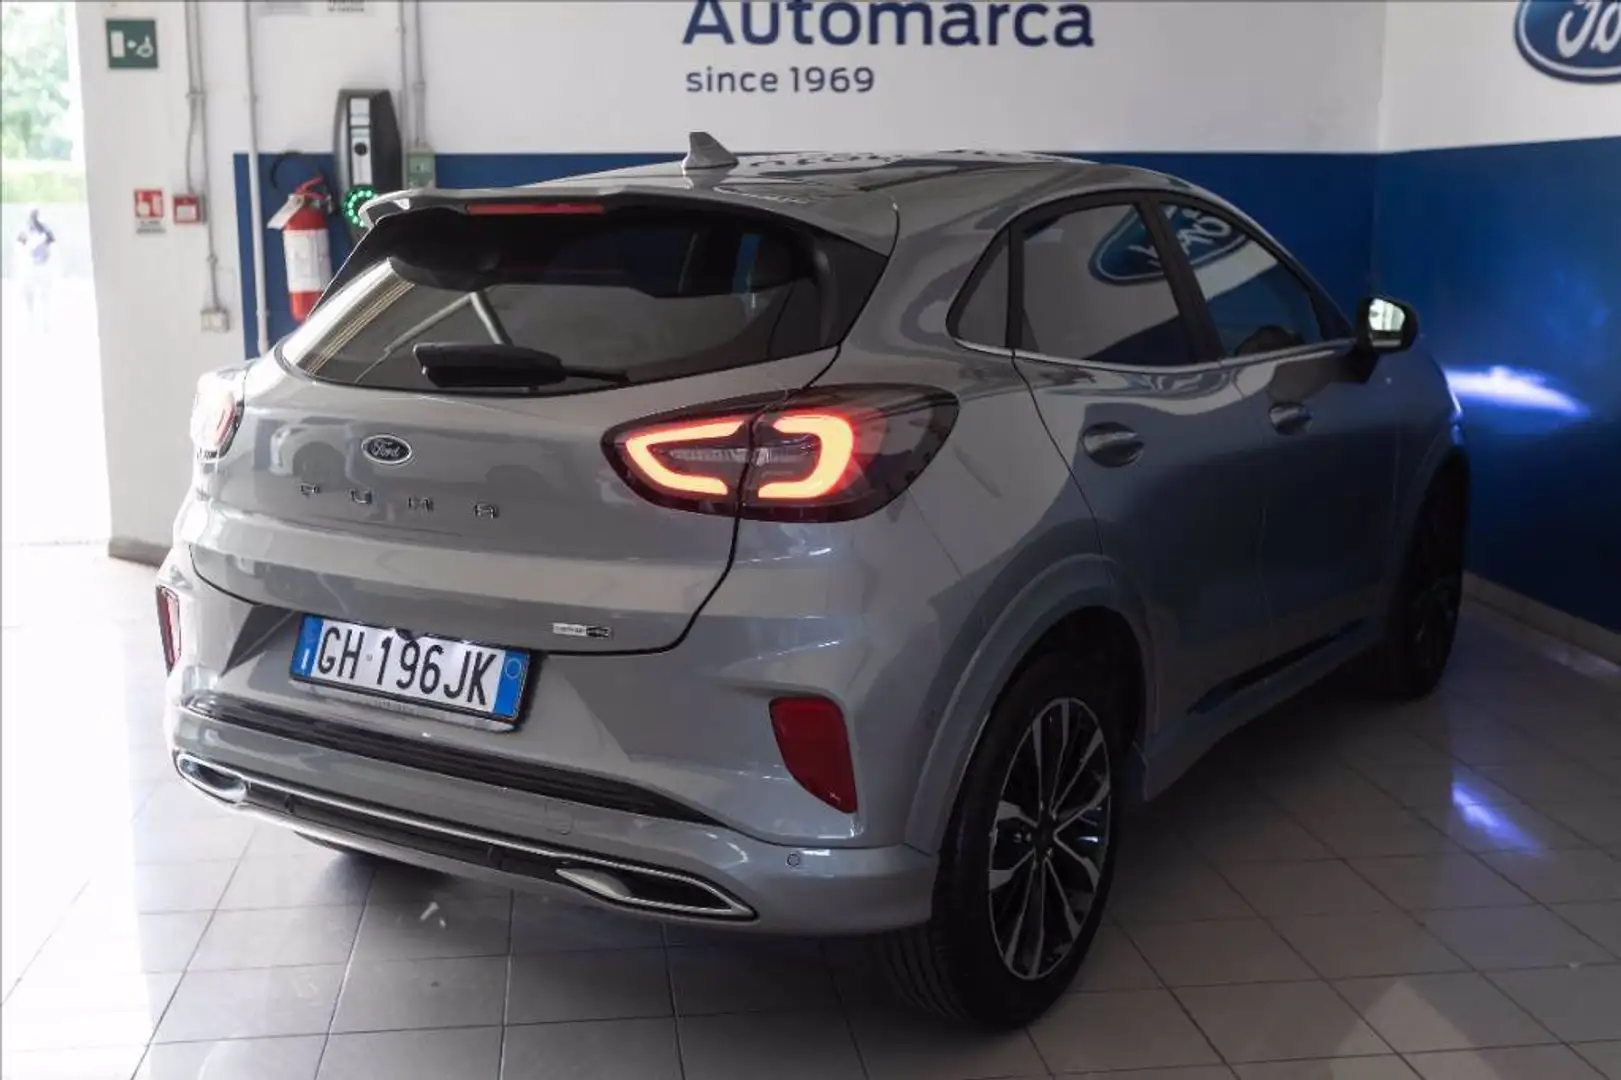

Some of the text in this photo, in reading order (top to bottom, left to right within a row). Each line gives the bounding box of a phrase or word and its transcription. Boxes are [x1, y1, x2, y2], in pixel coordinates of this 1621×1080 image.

[683, 1, 1094, 48] Automarca
[686, 66, 875, 93] since 1969
[369, 440, 400, 458] Ford
[317, 625, 364, 679] GH
